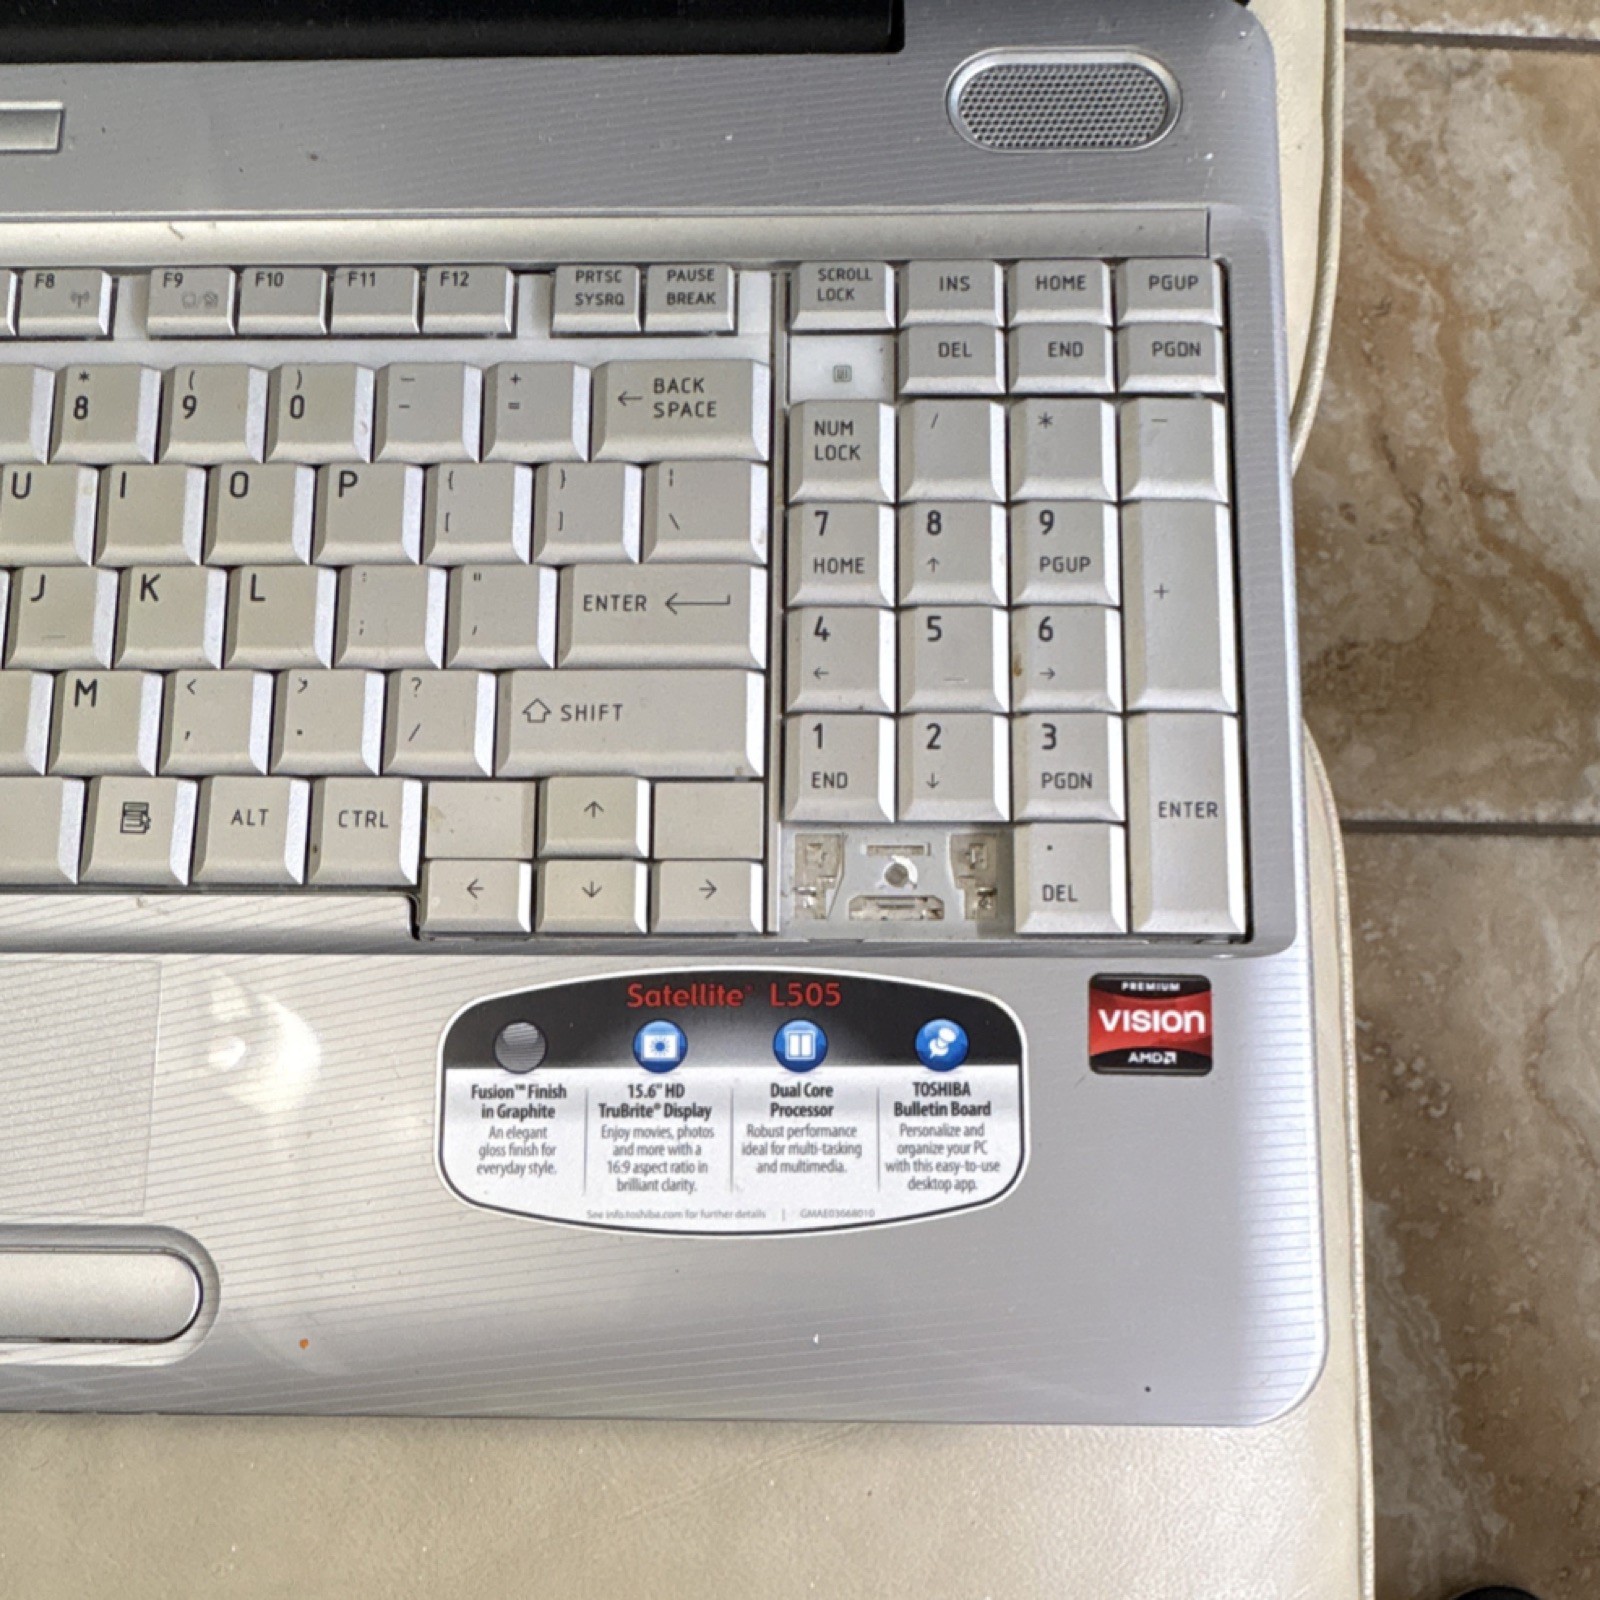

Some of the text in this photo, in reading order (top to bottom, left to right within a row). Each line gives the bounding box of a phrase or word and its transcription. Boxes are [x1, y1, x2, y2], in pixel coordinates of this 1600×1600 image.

[35, 274, 55, 288] F8
[163, 273, 183, 287] F9
[255, 273, 284, 287] F10
[347, 273, 376, 287] F11
[440, 272, 470, 287] F12
[575, 270, 623, 283] PRTSC
[667, 269, 715, 282] PAUSE
[817, 268, 873, 282] SCROLL
[1035, 275, 1087, 291] HOME
[1148, 275, 1198, 291] PGUP
[939, 276, 970, 292] INS
[575, 293, 624, 306] SYSRQ
[666, 292, 716, 305] BREAK
[817, 288, 855, 301] LOCK
[938, 342, 972, 358] DEL
[1047, 342, 1083, 358] END
[1152, 341, 1200, 357] PGDN
[653, 377, 705, 394] BACK
[74, 396, 89, 419] 8
[183, 395, 197, 419] 9
[653, 401, 717, 418] SPACE
[814, 420, 854, 436] NUM
[814, 445, 861, 461] LOCK
[11, 472, 32, 498] U
[120, 472, 126, 498] I
[229, 471, 249, 497] O
[339, 471, 358, 497] P
[814, 511, 829, 535] 7
[926, 510, 942, 535] 8
[1039, 510, 1054, 534] 9
[813, 557, 865, 574] HOME
[1040, 557, 1091, 573] PGUP
[30, 574, 46, 602] J
[140, 574, 161, 601] K
[251, 574, 266, 601] L
[583, 595, 647, 612] ENTER
[814, 616, 830, 641] 4
[926, 616, 942, 641] 5
[1039, 616, 1054, 641] 6
[74, 679, 98, 707] M
[412, 677, 422, 698] ?
[560, 704, 623, 722] SHIFT
[812, 724, 823, 749] 1
[926, 724, 942, 749] 2
[1042, 724, 1057, 749] 3
[811, 772, 848, 789] END
[1041, 772, 1093, 789] PGDN
[230, 809, 269, 826] ALT
[1158, 801, 1219, 818] ENTER
[338, 810, 389, 828] CTRL
[1042, 885, 1077, 902] DEL
[1121, 981, 1180, 991] PREMIUM
[770, 983, 841, 1007] L505
[1128, 1052, 1163, 1064] AMD
[527, 1083, 567, 1099] Finish
[665, 1083, 685, 1098] HD
[770, 1082, 834, 1097] Dual Core
[913, 1082, 971, 1096] TOSHIBA
[482, 1103, 555, 1122] in Graphite
[663, 1102, 712, 1121] Display
[770, 1102, 834, 1117] Processor
[894, 1101, 991, 1116] Bulletin Board
[489, 1126, 547, 1143] An elegant
[601, 1126, 631, 1142] Enjoy
[677, 1126, 714, 1142] photos
[746, 1124, 857, 1140] Robust performance
[899, 1124, 984, 1137] Personalize and
[478, 1144, 557, 1159] gloss finish for
[612, 1144, 702, 1156] and more with a
[742, 1142, 862, 1158] ideal for multi-tasking
[897, 1142, 988, 1157] organize your PC
[476, 1162, 557, 1177] everyday style.
[608, 1162, 708, 1177] 16:9 aspect ratio in
[757, 1161, 847, 1173] and multimedia.
[885, 1160, 1000, 1175] with this easy-to-use
[617, 1179, 697, 1194] brilliant clarity.
[908, 1178, 978, 1193] desktop app.
[586, 1210, 603, 1219] See
[700, 1209, 732, 1219] further
[735, 1209, 766, 1219] details
